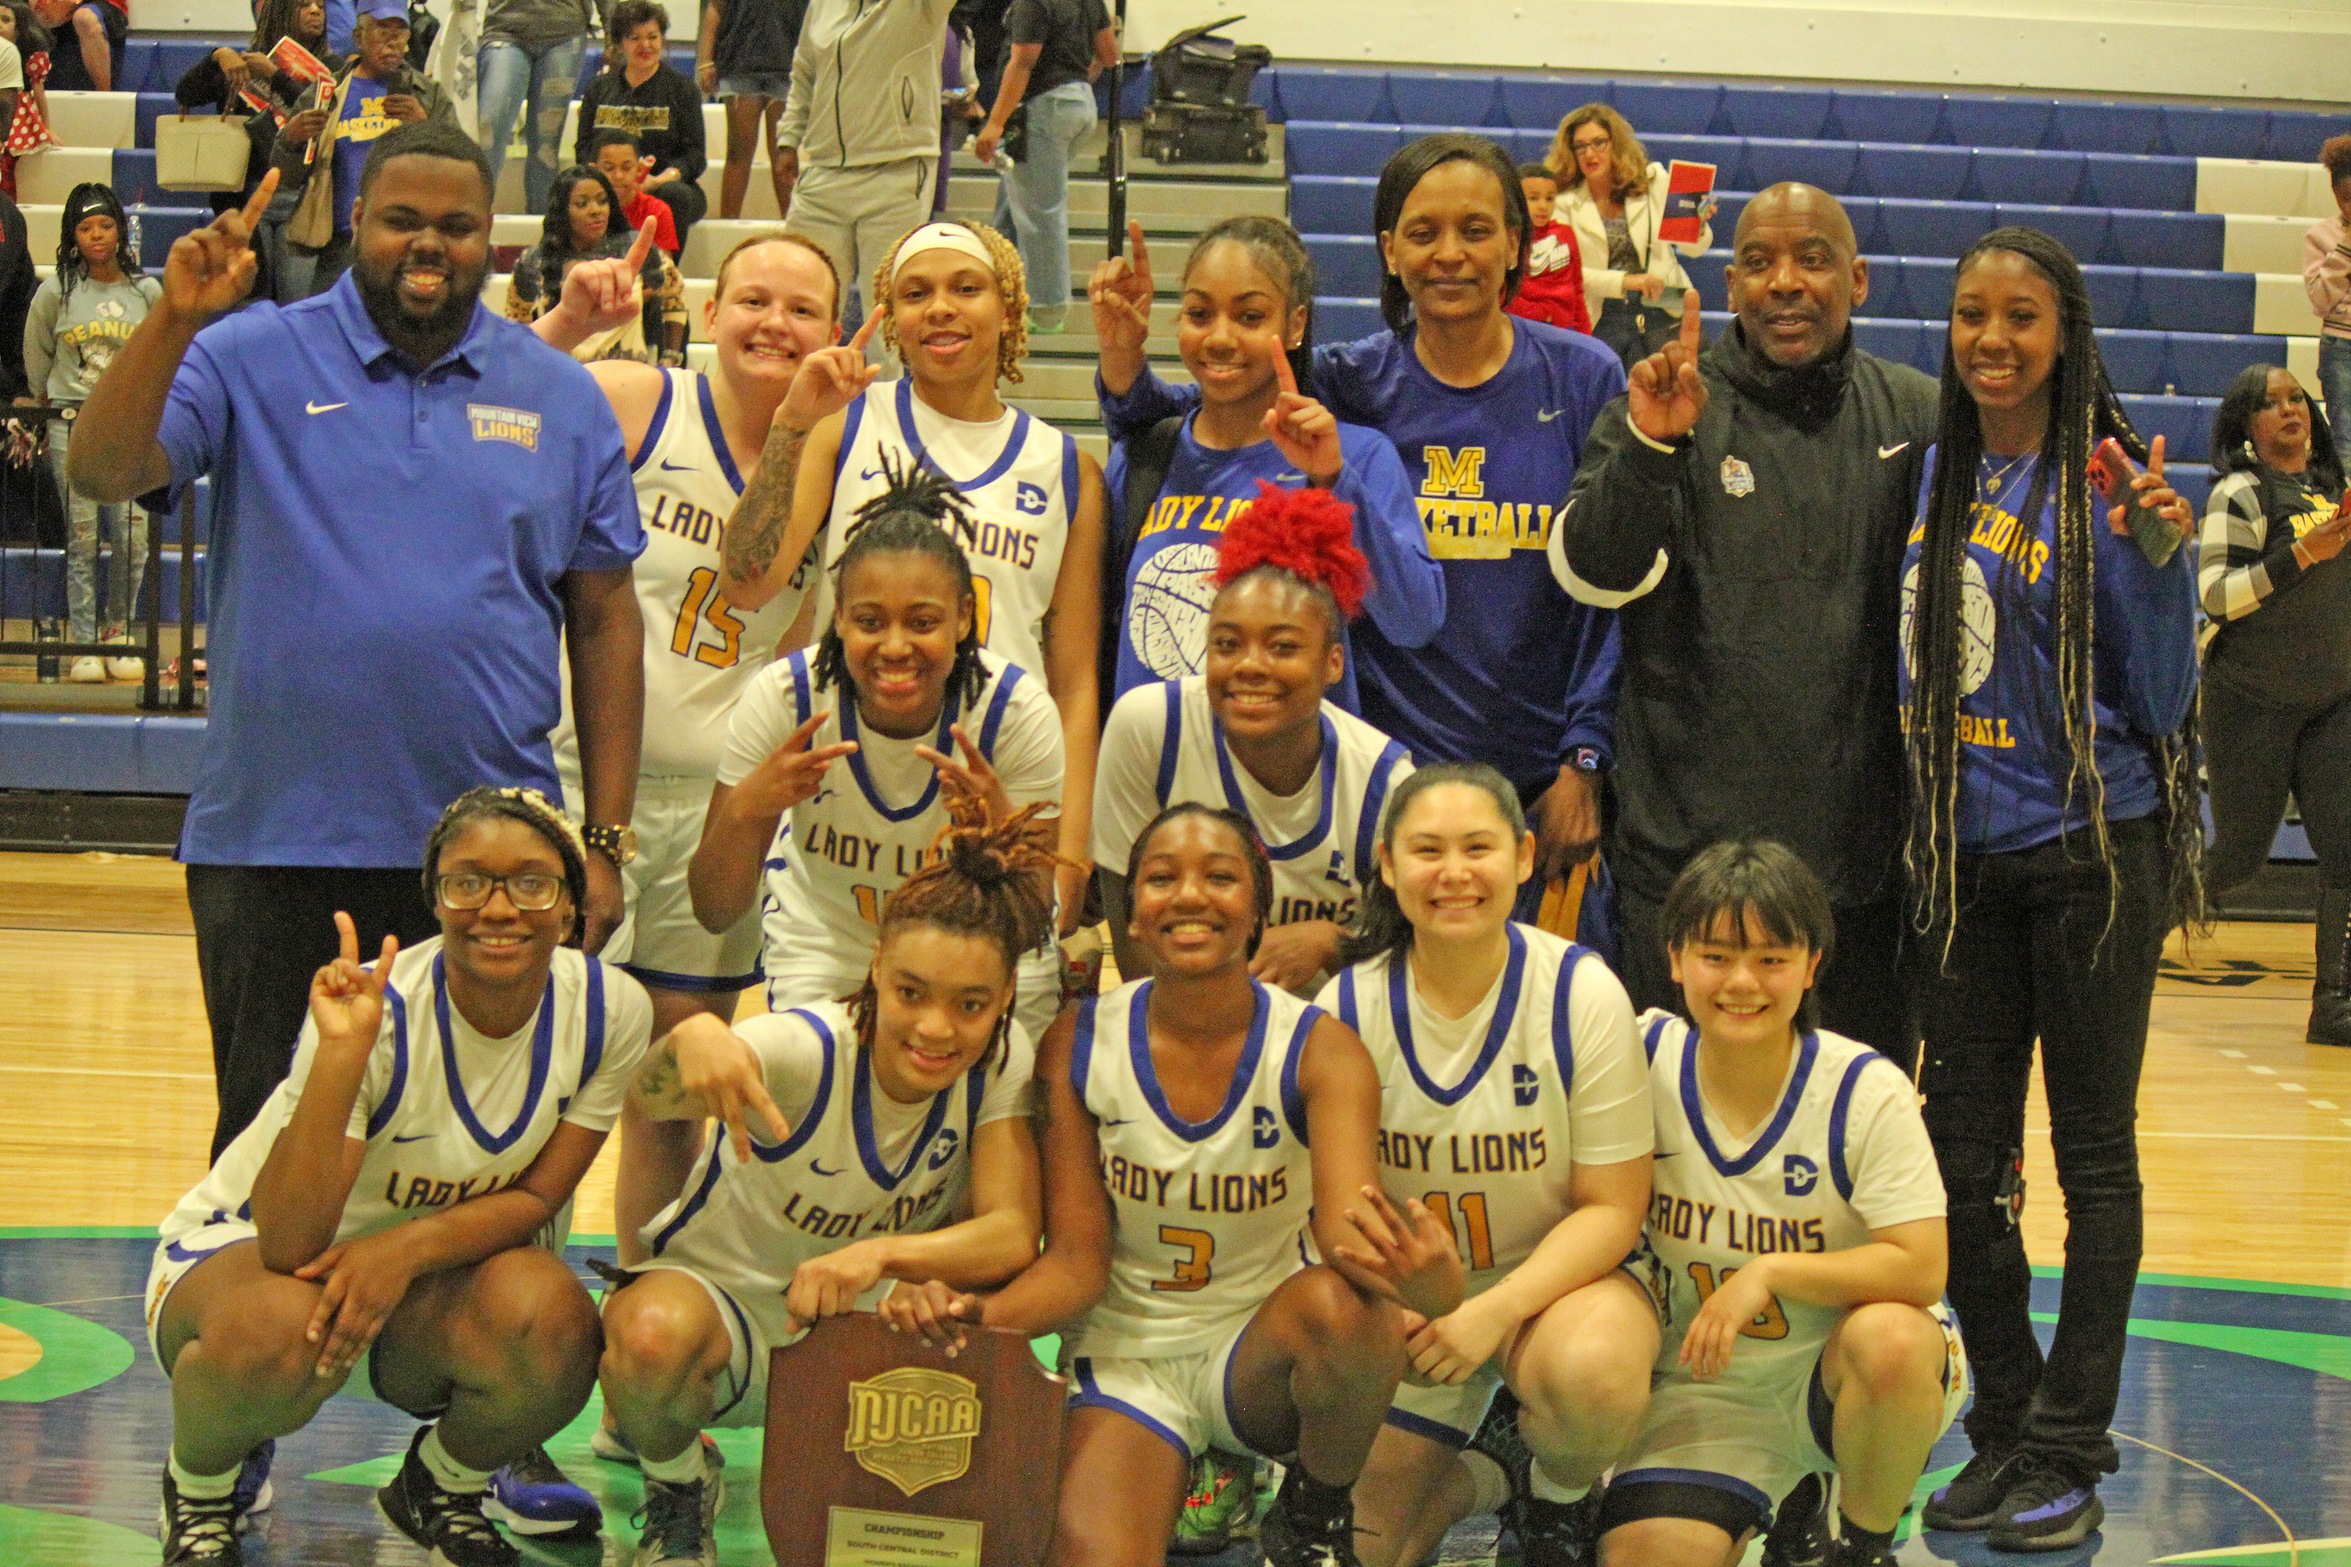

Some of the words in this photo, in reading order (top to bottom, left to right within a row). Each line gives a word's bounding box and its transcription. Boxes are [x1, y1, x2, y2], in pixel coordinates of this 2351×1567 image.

[64, 320, 136, 346] PEANU
[476, 419, 535, 447] LIONS
[1421, 446, 1486, 498] M
[1138, 495, 1206, 541] ADY
[1414, 497, 1552, 550] KETBALL
[671, 566, 746, 669] 15
[805, 823, 882, 873] LADY
[1279, 896, 1358, 926] IONS
[1378, 1129, 1435, 1173] ADY
[1451, 1127, 1547, 1175] LIONS
[386, 1171, 479, 1210] LADY
[1189, 1165, 1288, 1214] LIONS
[1728, 1209, 1827, 1255] LIONS
[1151, 1223, 1216, 1293] 3
[852, 1389, 975, 1444] NJCAA
[847, 1540, 877, 1551] SOUTH
[878, 1544, 917, 1555] CENTRAL
[920, 1549, 960, 1560] DISTRICT
[863, 1522, 946, 1541] CHAMPIONSHIP
